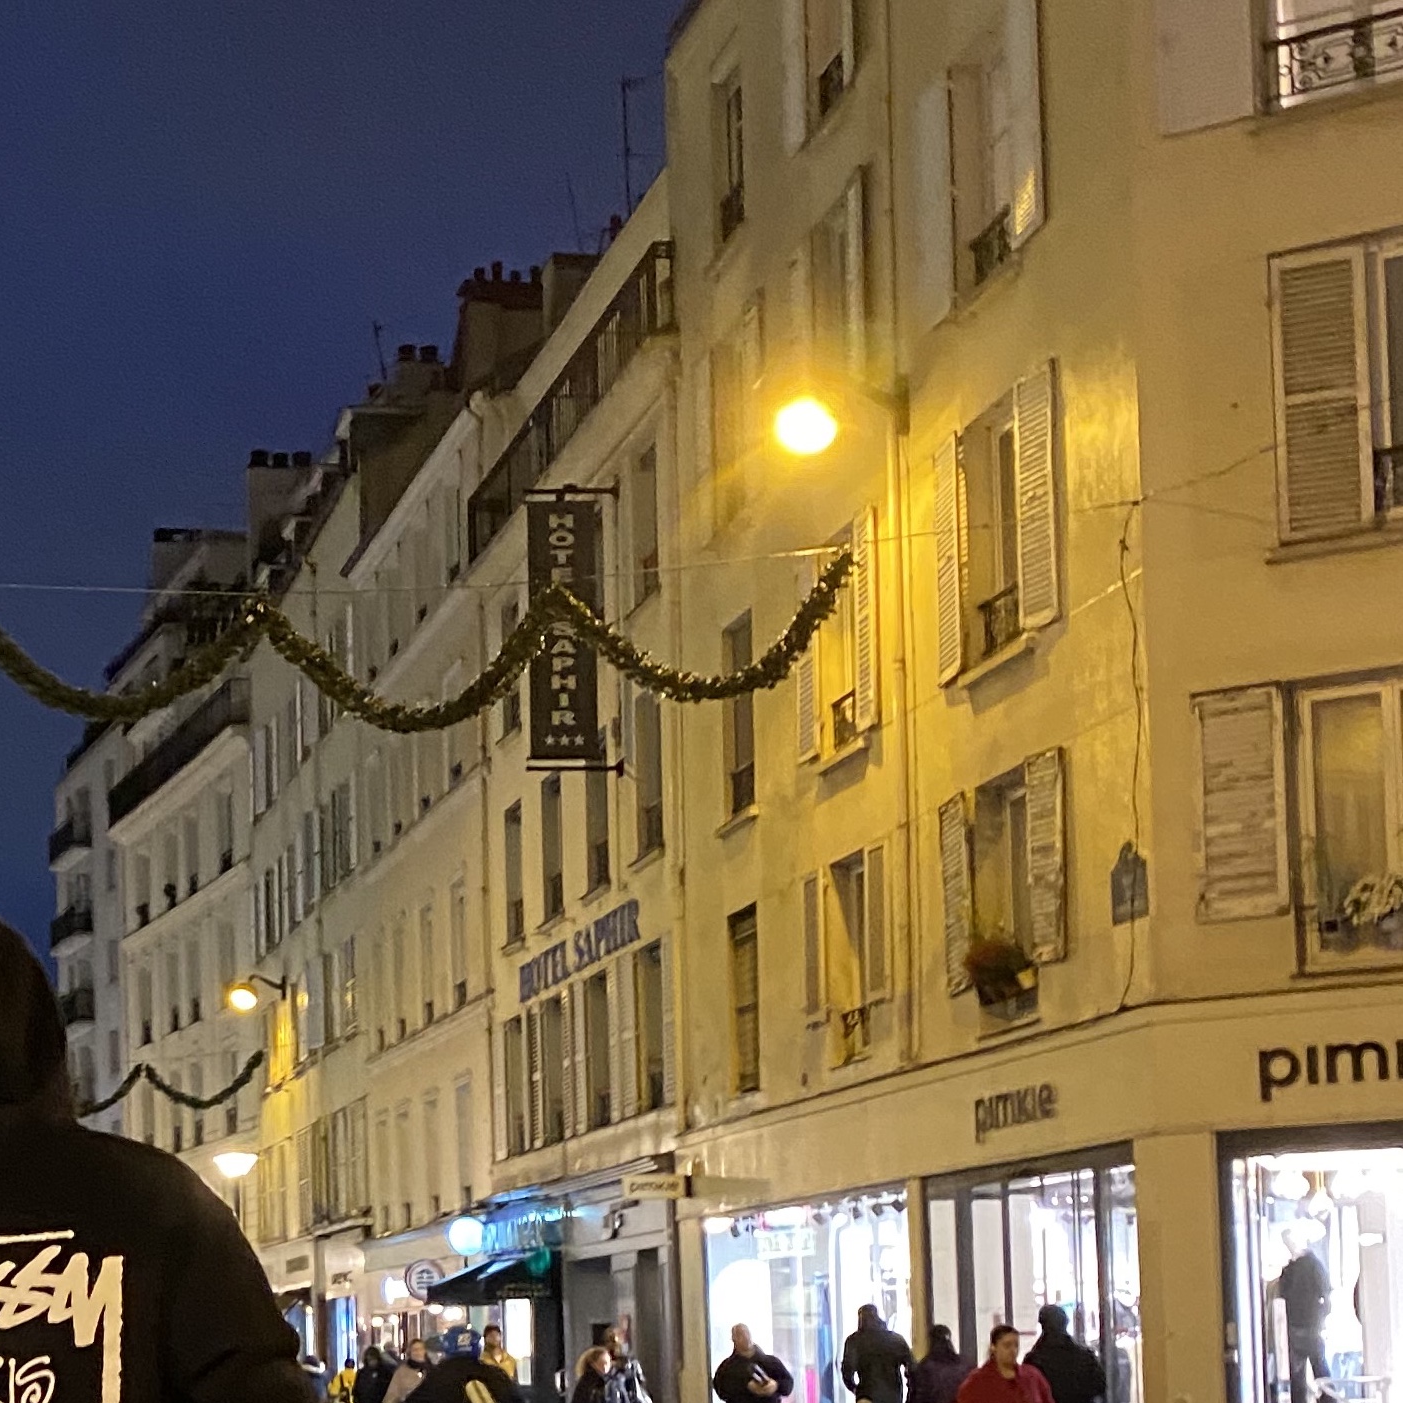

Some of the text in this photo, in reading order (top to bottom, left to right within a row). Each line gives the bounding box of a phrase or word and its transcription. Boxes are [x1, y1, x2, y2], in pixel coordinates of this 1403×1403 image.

[548, 513, 576, 590] HOTE
[548, 621, 578, 726] SAPHIR
[1258, 1038, 1403, 1103] pim
[974, 1083, 1057, 1145] pimkie
